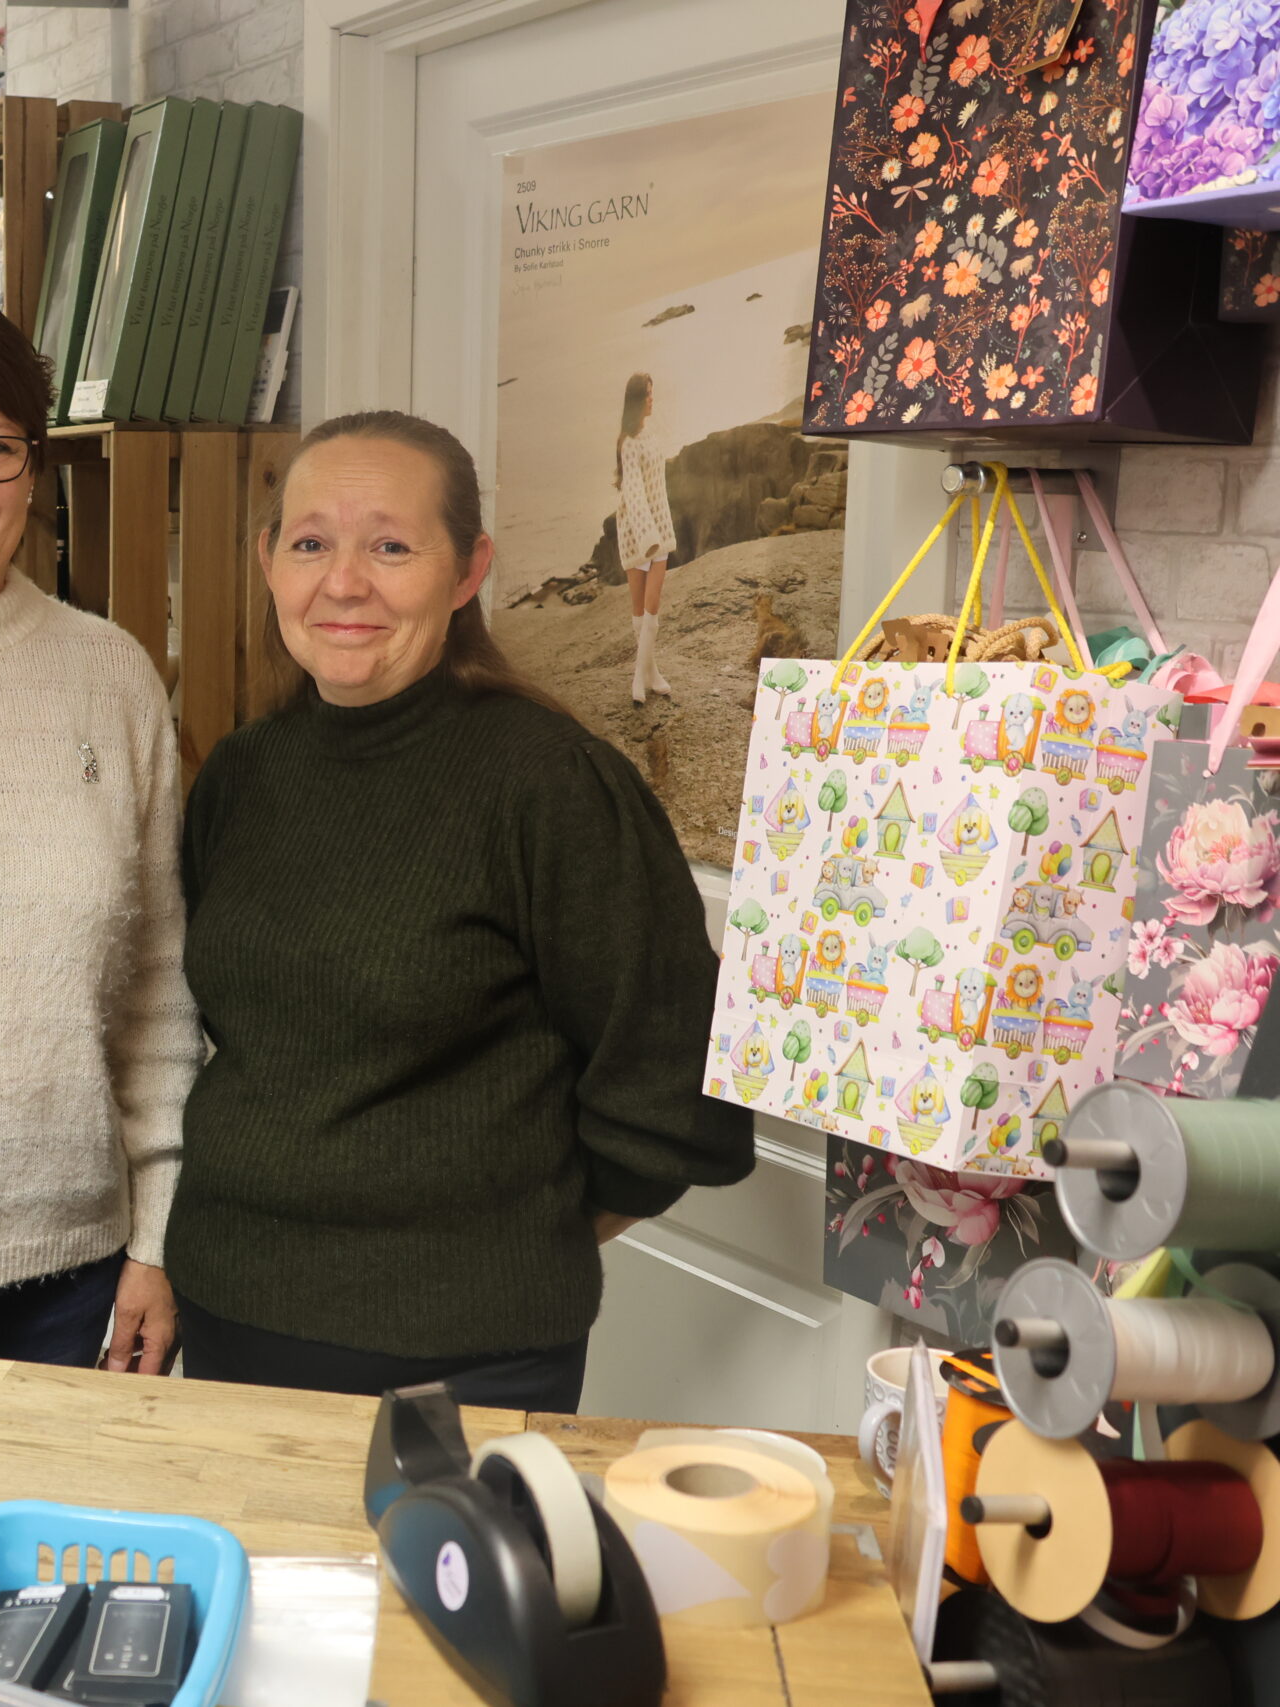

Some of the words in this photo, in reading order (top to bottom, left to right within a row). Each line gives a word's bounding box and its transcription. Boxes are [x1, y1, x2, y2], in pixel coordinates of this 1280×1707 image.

[517, 180, 536, 194] 2509
[516, 202, 582, 234] VIKING
[587, 193, 649, 225] GARN
[514, 244, 546, 259] Chunky
[548, 241, 571, 255] strikk
[573, 240, 577, 251] i
[578, 237, 610, 250] Snorre
[130, 310, 142, 325] Vi
[150, 195, 168, 230] Norge
[161, 311, 173, 326] Vi
[180, 196, 197, 232] Norge
[523, 261, 538, 272] Sofie
[189, 313, 200, 327] Vi
[221, 311, 232, 326] Vi
